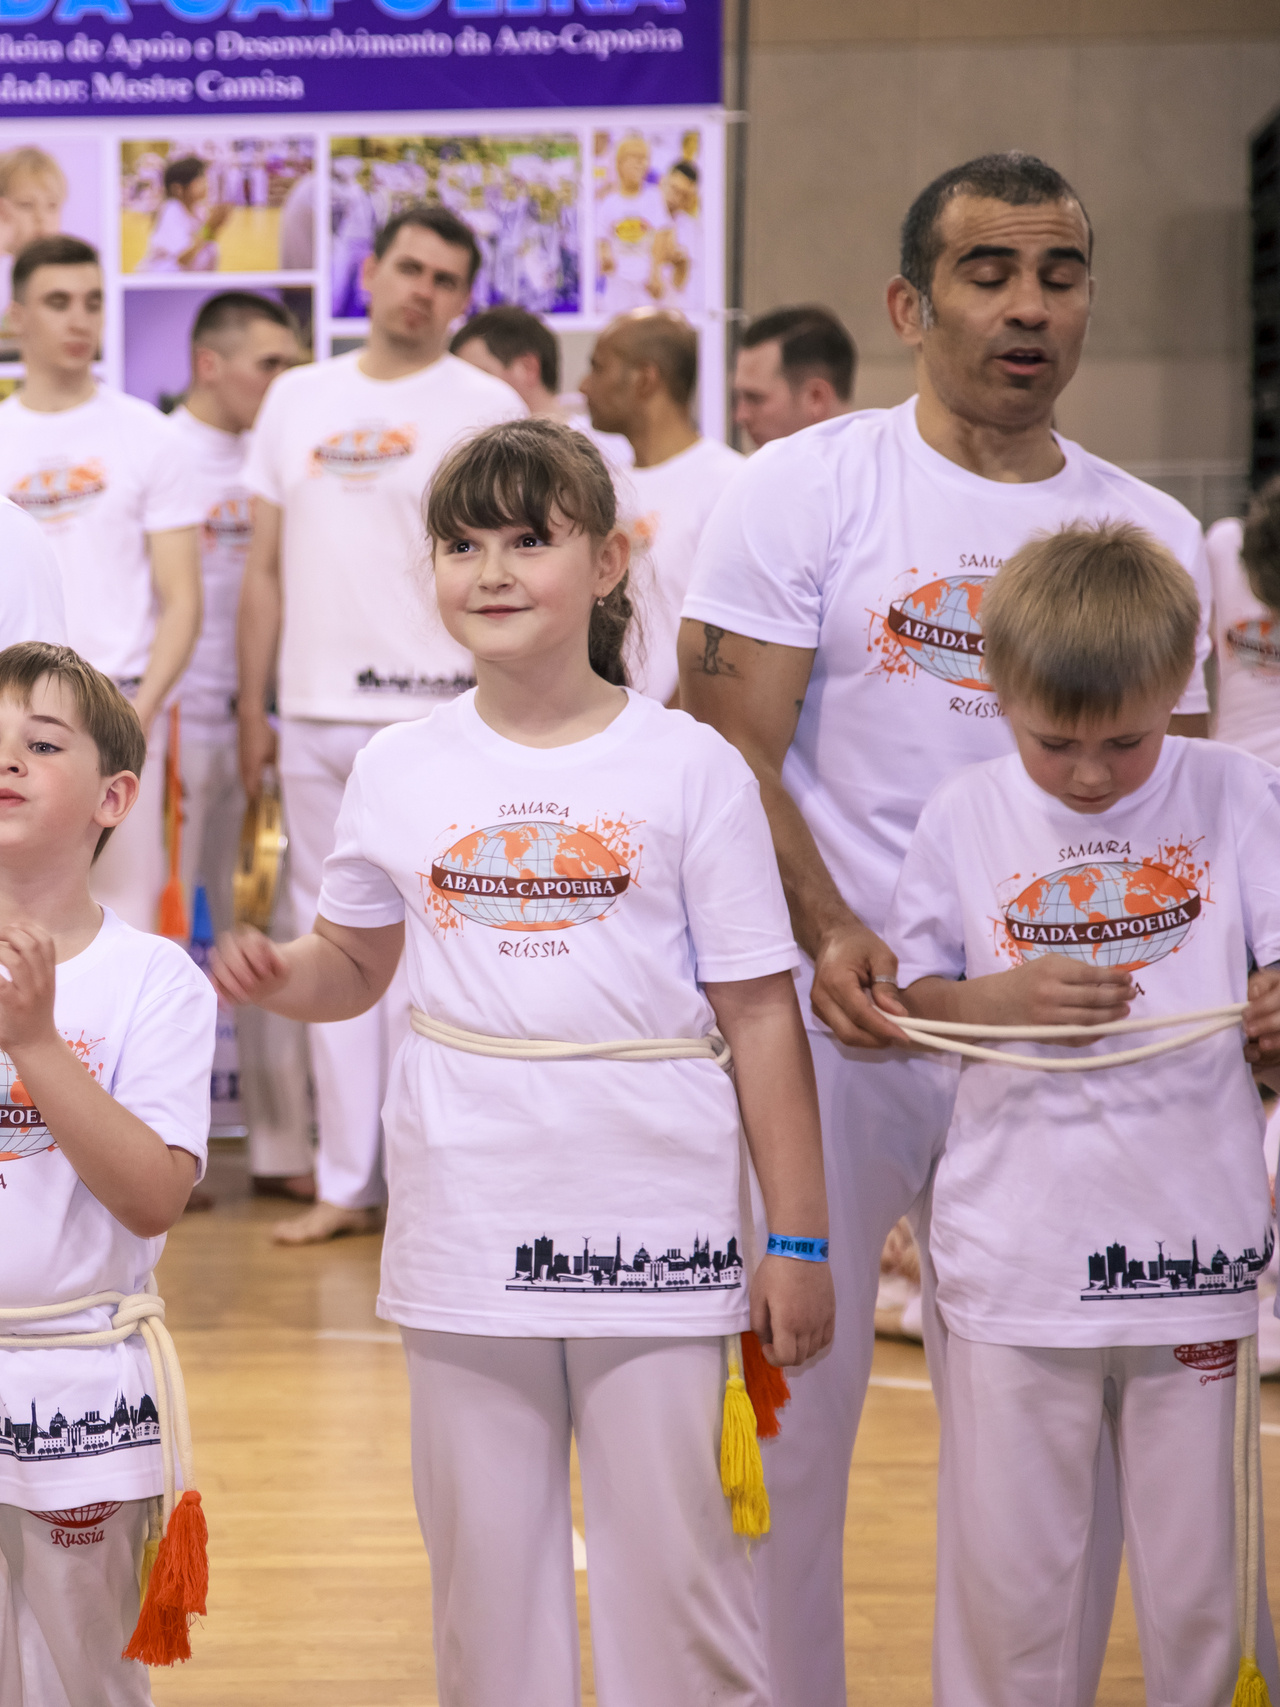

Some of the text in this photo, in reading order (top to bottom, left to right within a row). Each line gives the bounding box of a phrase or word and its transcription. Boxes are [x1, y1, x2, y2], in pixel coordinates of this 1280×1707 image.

[949, 696, 1005, 718] RÚSSI
[498, 801, 570, 818] SAMARA
[1058, 840, 1132, 862] SAMARA
[441, 874, 616, 897] ABADÁ-CAPOEIRA
[1011, 908, 1190, 942] ABADÁ-CAPOEIRA
[498, 937, 570, 958] RÚSSIA
[50, 1527, 104, 1548] Russia
